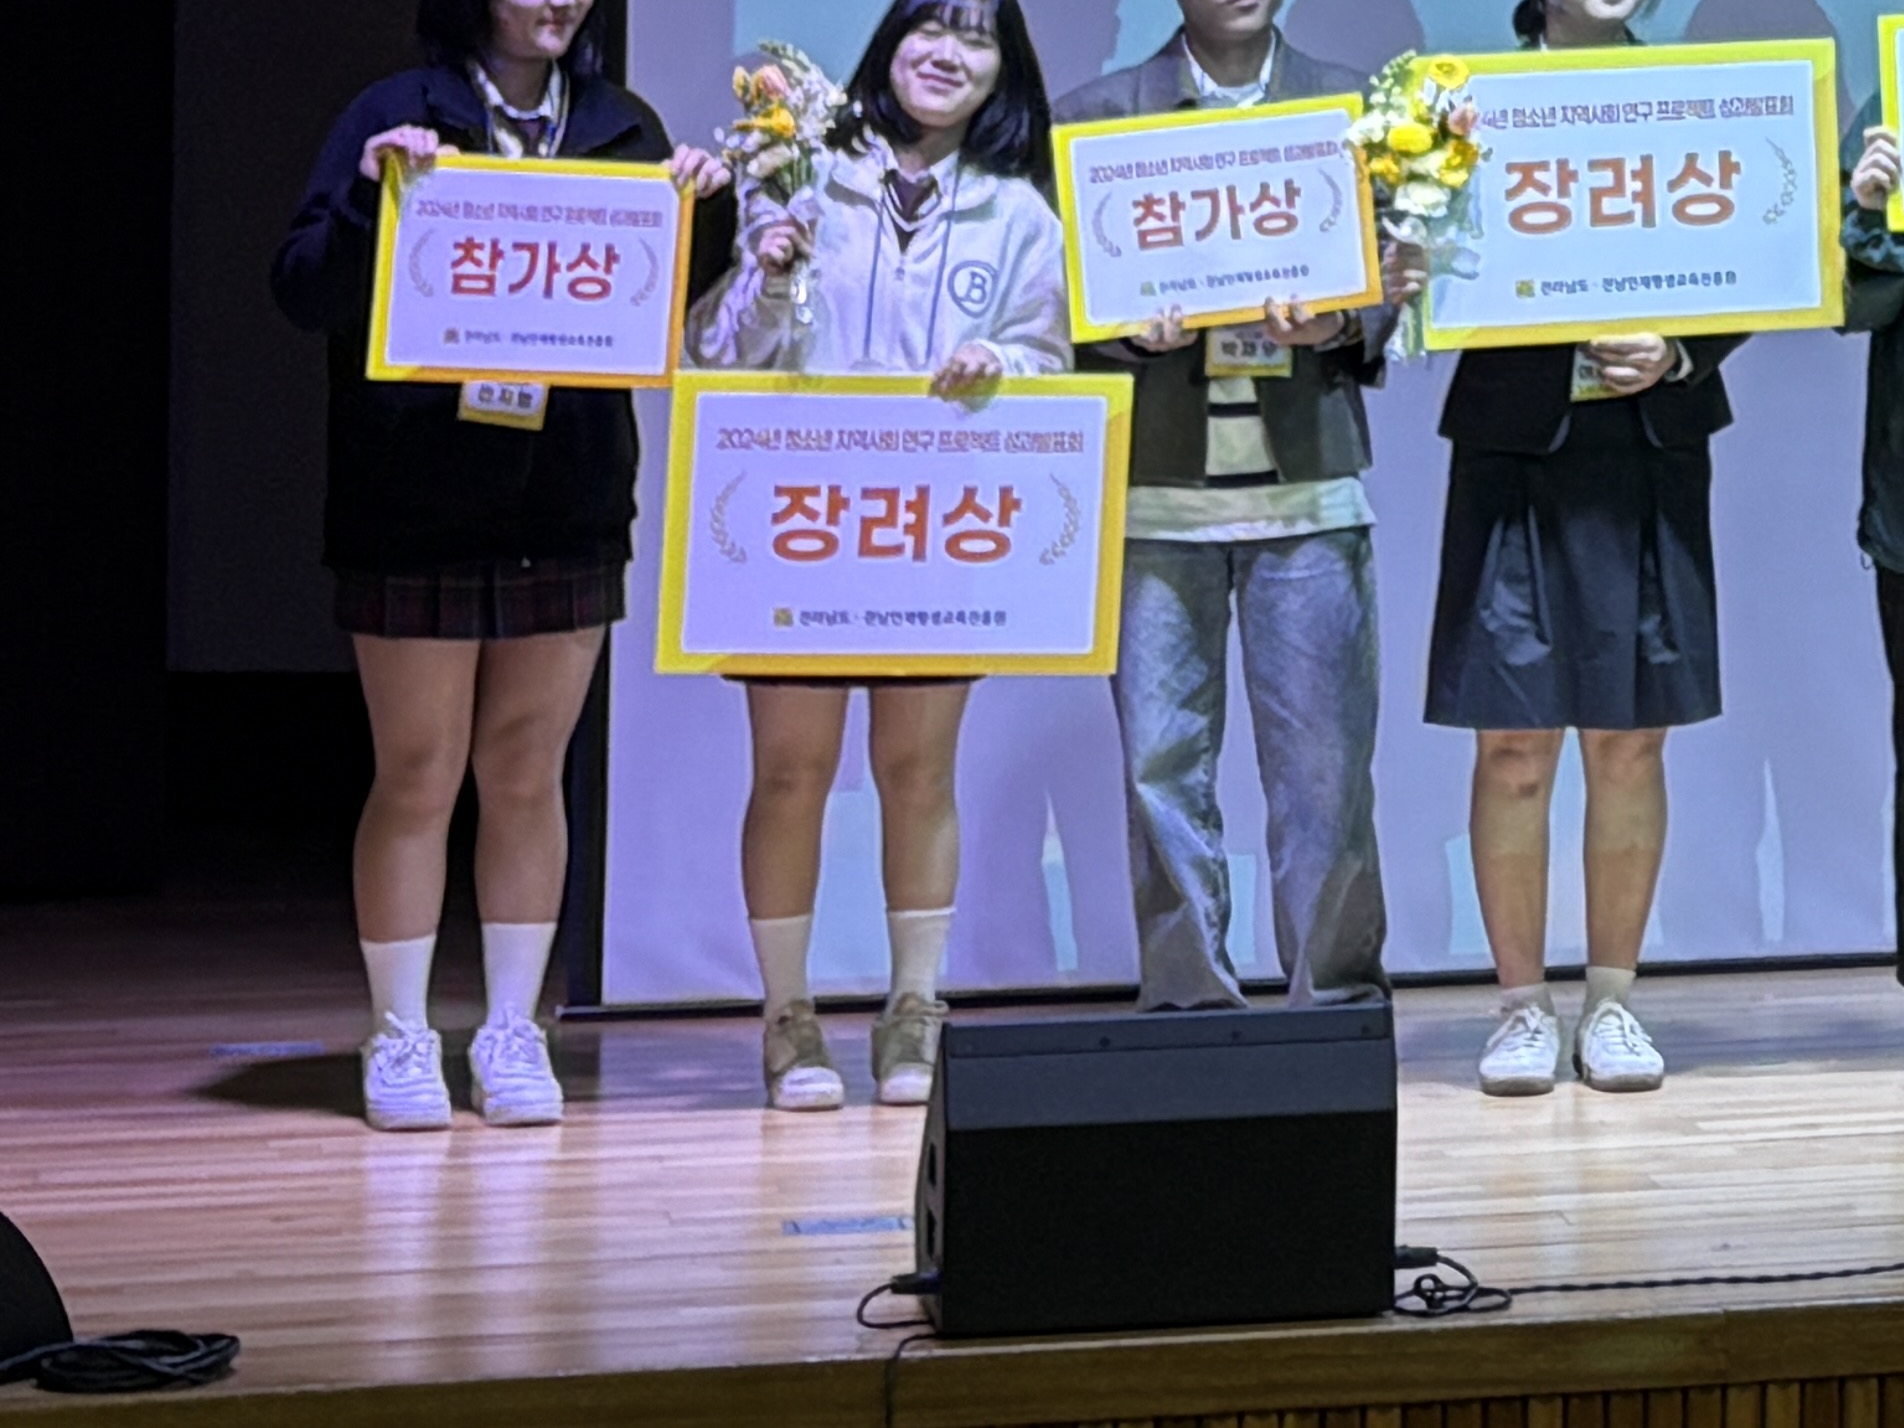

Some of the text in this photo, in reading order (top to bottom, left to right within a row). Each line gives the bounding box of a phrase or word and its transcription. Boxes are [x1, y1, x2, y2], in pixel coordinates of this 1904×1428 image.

[1132, 178, 1301, 251] 참가상
[1505, 150, 1741, 234] 장려상
[451, 237, 620, 300] 참가상
[771, 485, 1021, 562] 장려상
